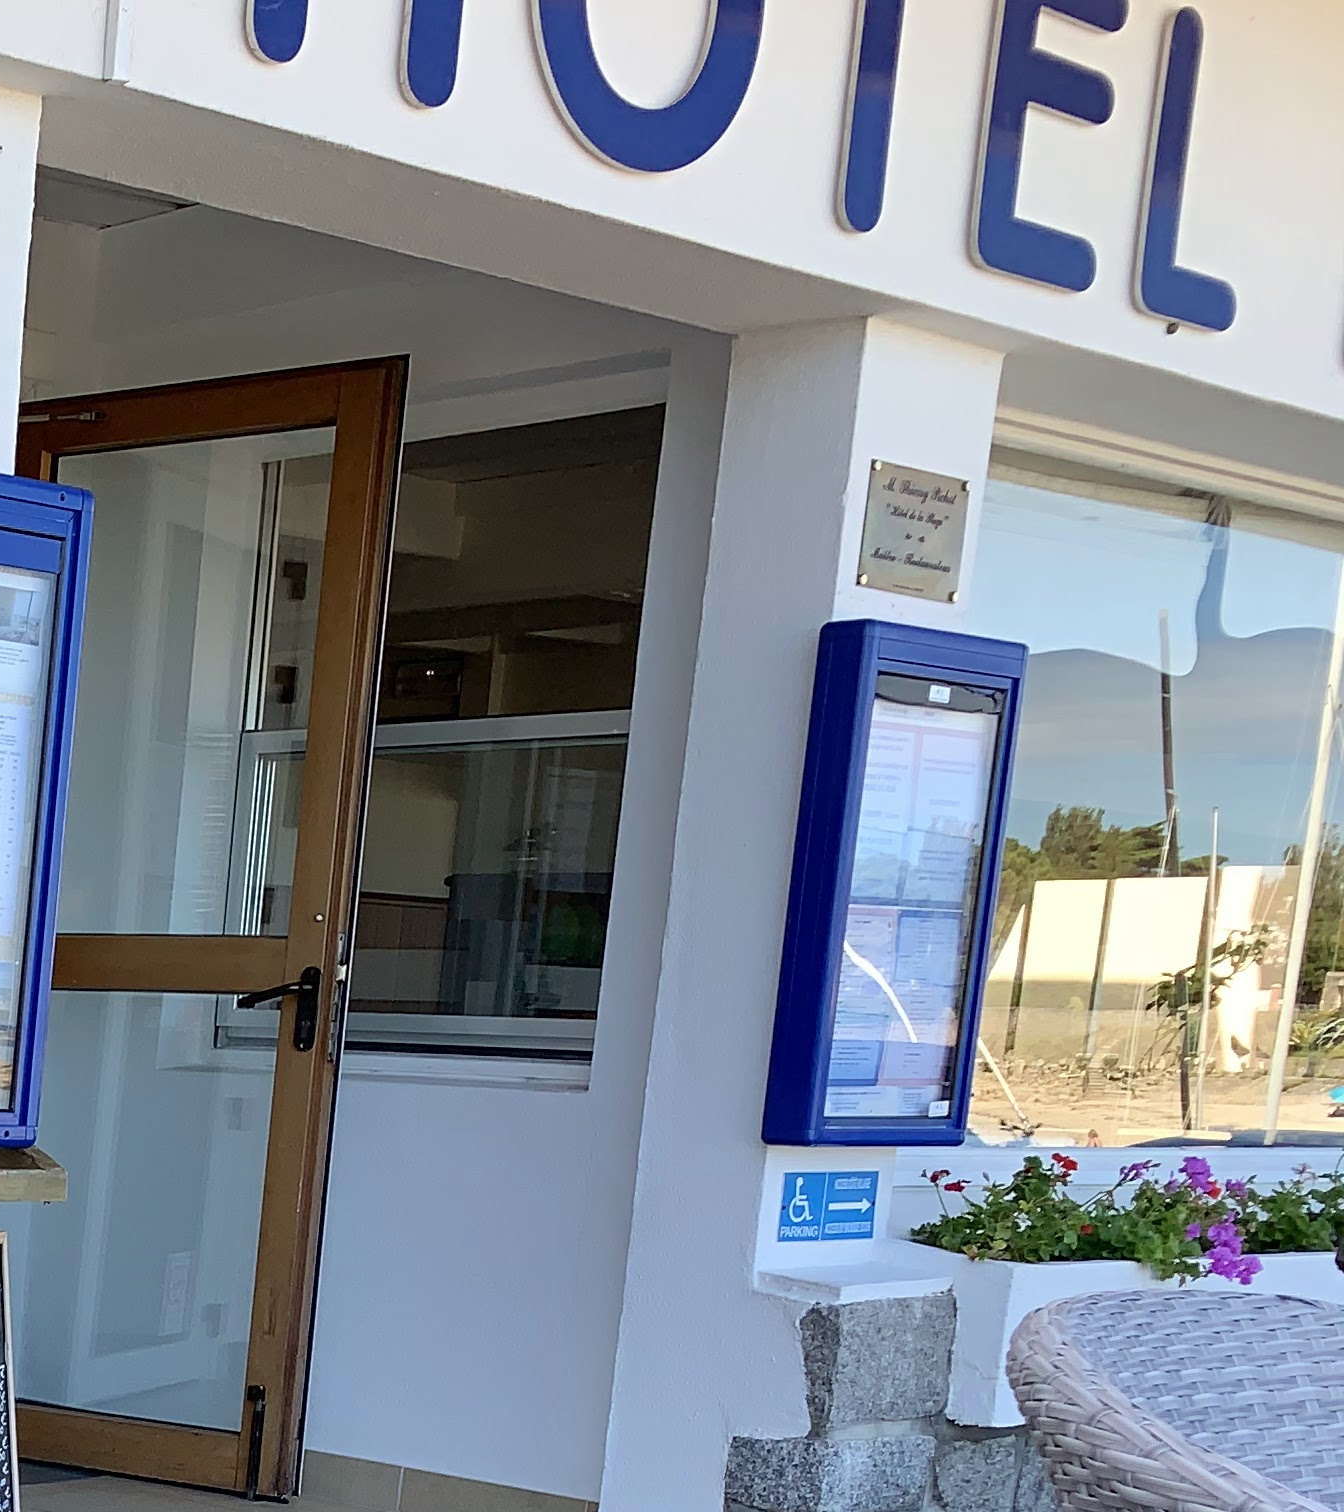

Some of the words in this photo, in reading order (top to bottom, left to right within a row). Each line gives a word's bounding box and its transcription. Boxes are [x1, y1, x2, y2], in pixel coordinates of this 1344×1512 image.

[248, 0, 1237, 332] OTEL
[909, 508, 917, 521] de
[780, 1225, 819, 1238] PARKING
